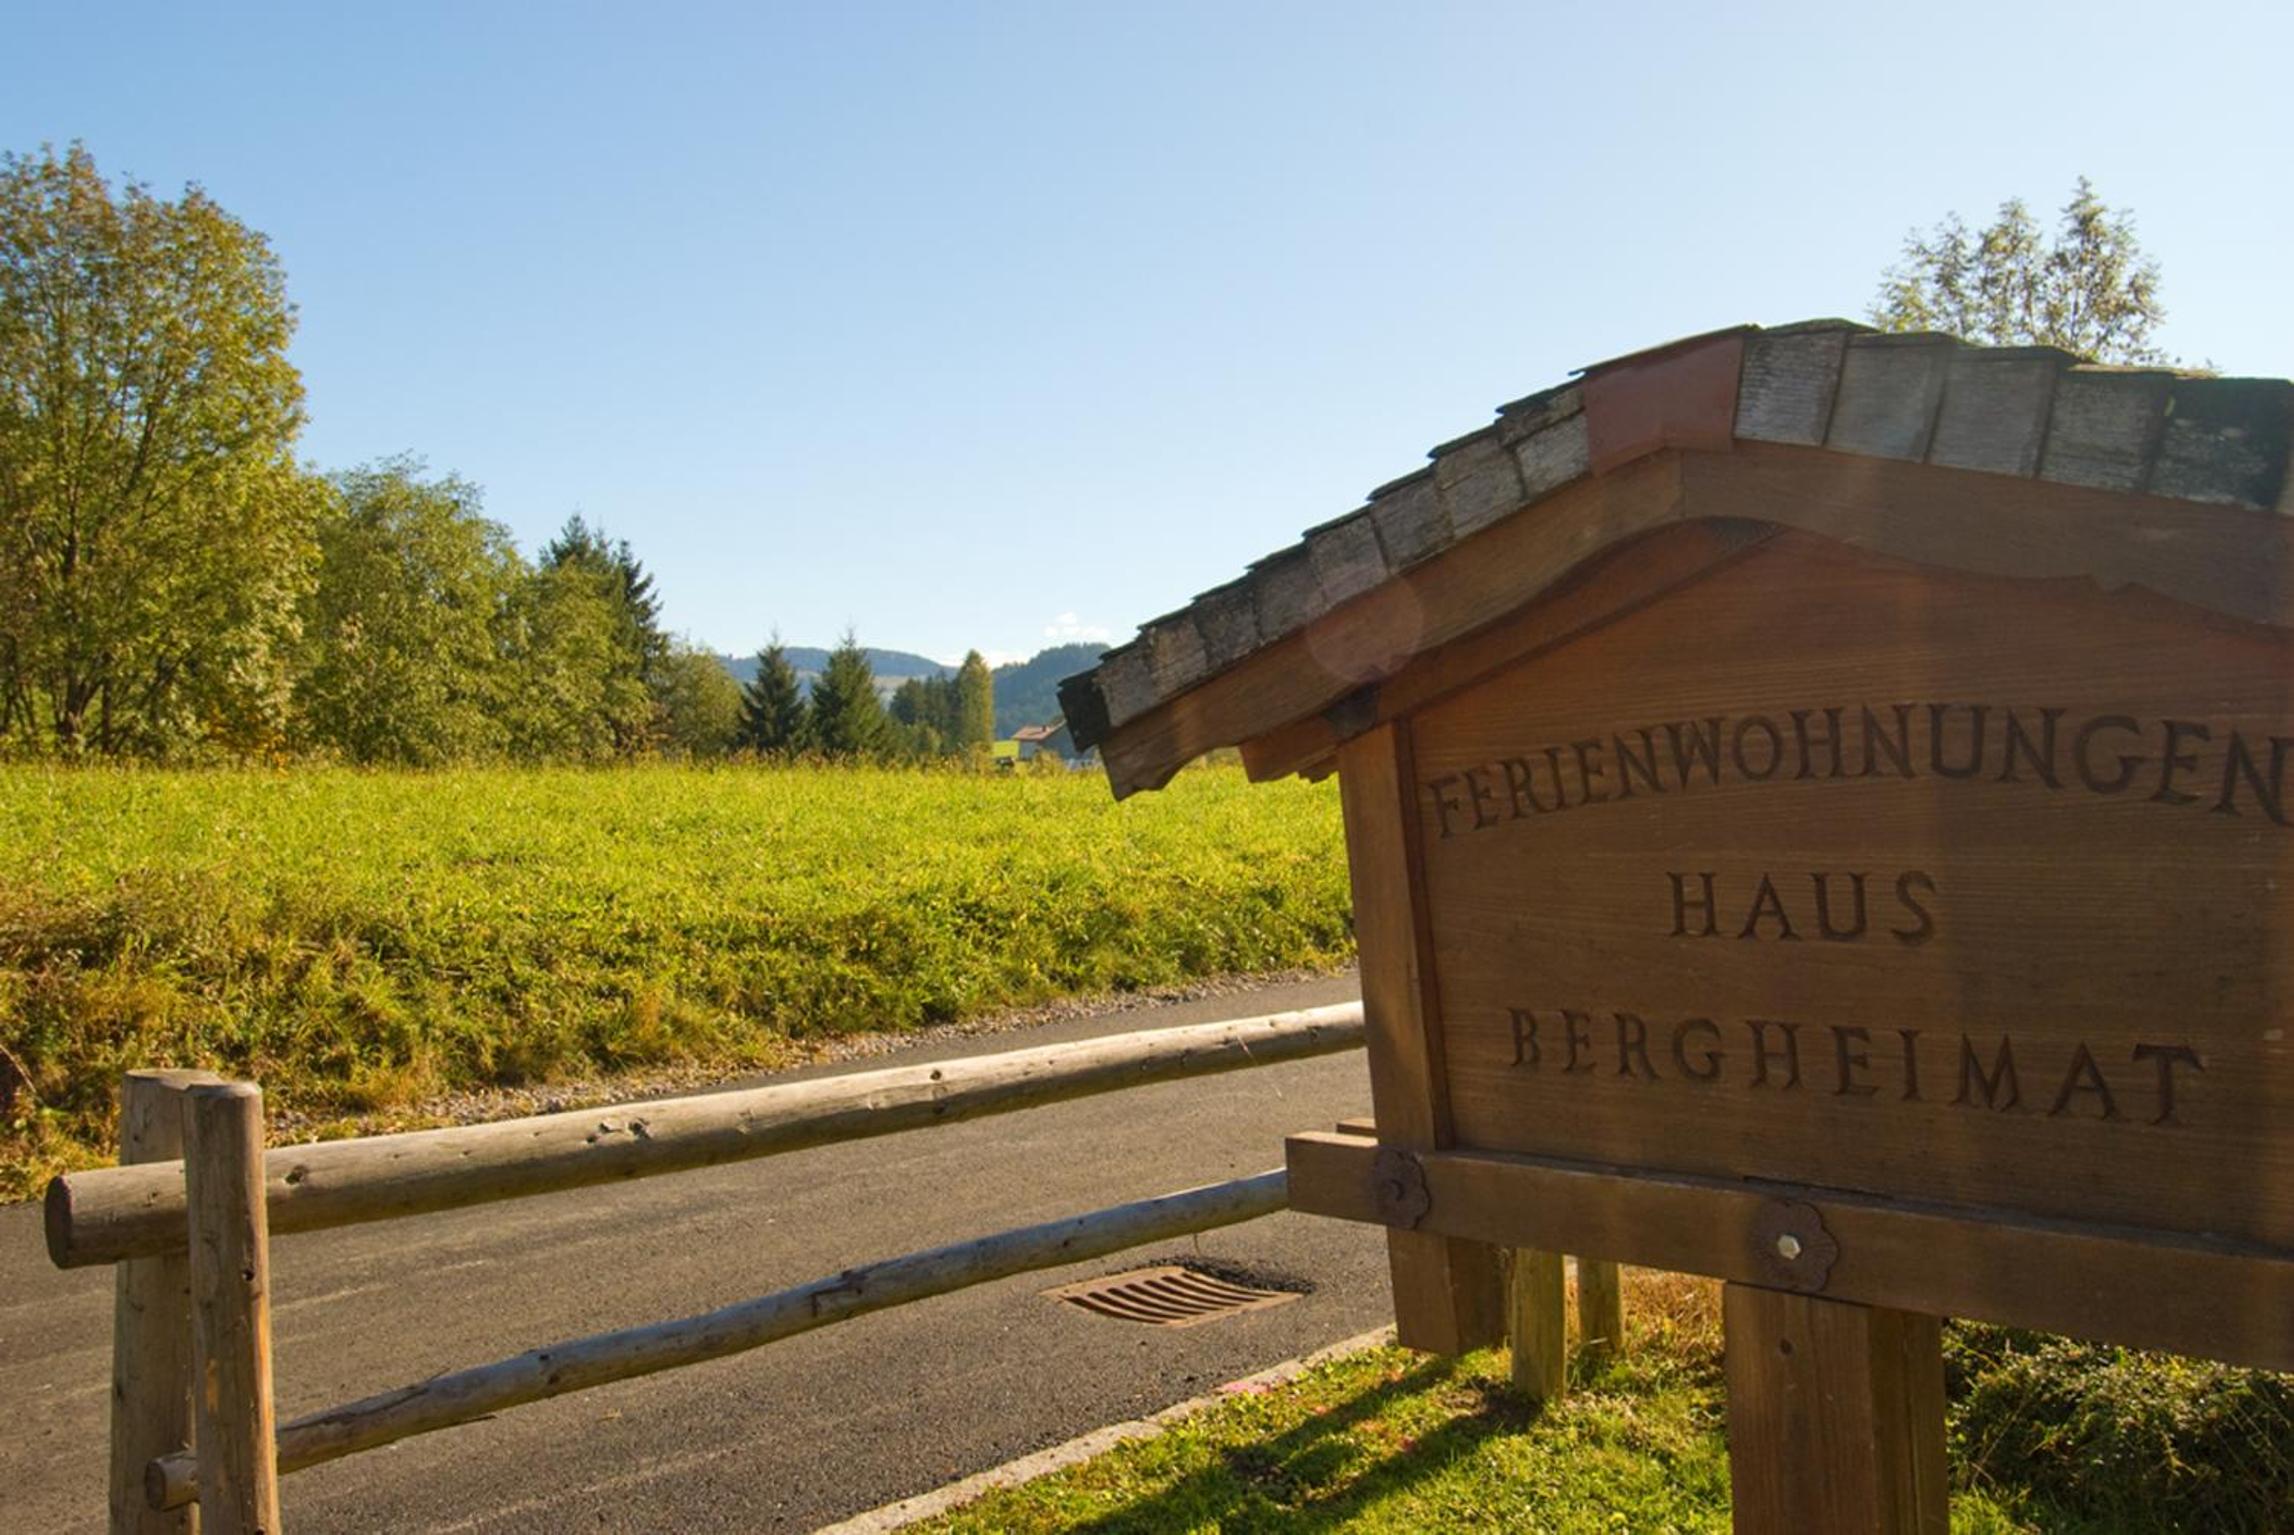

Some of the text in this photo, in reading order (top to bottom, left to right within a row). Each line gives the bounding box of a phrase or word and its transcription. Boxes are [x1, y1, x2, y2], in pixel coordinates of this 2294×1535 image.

[1427, 703, 2294, 840] FERIENWOHNUNGEN
[1665, 869, 1939, 946] HAUS
[1507, 1006, 2206, 1126] BERGHEIMAT
